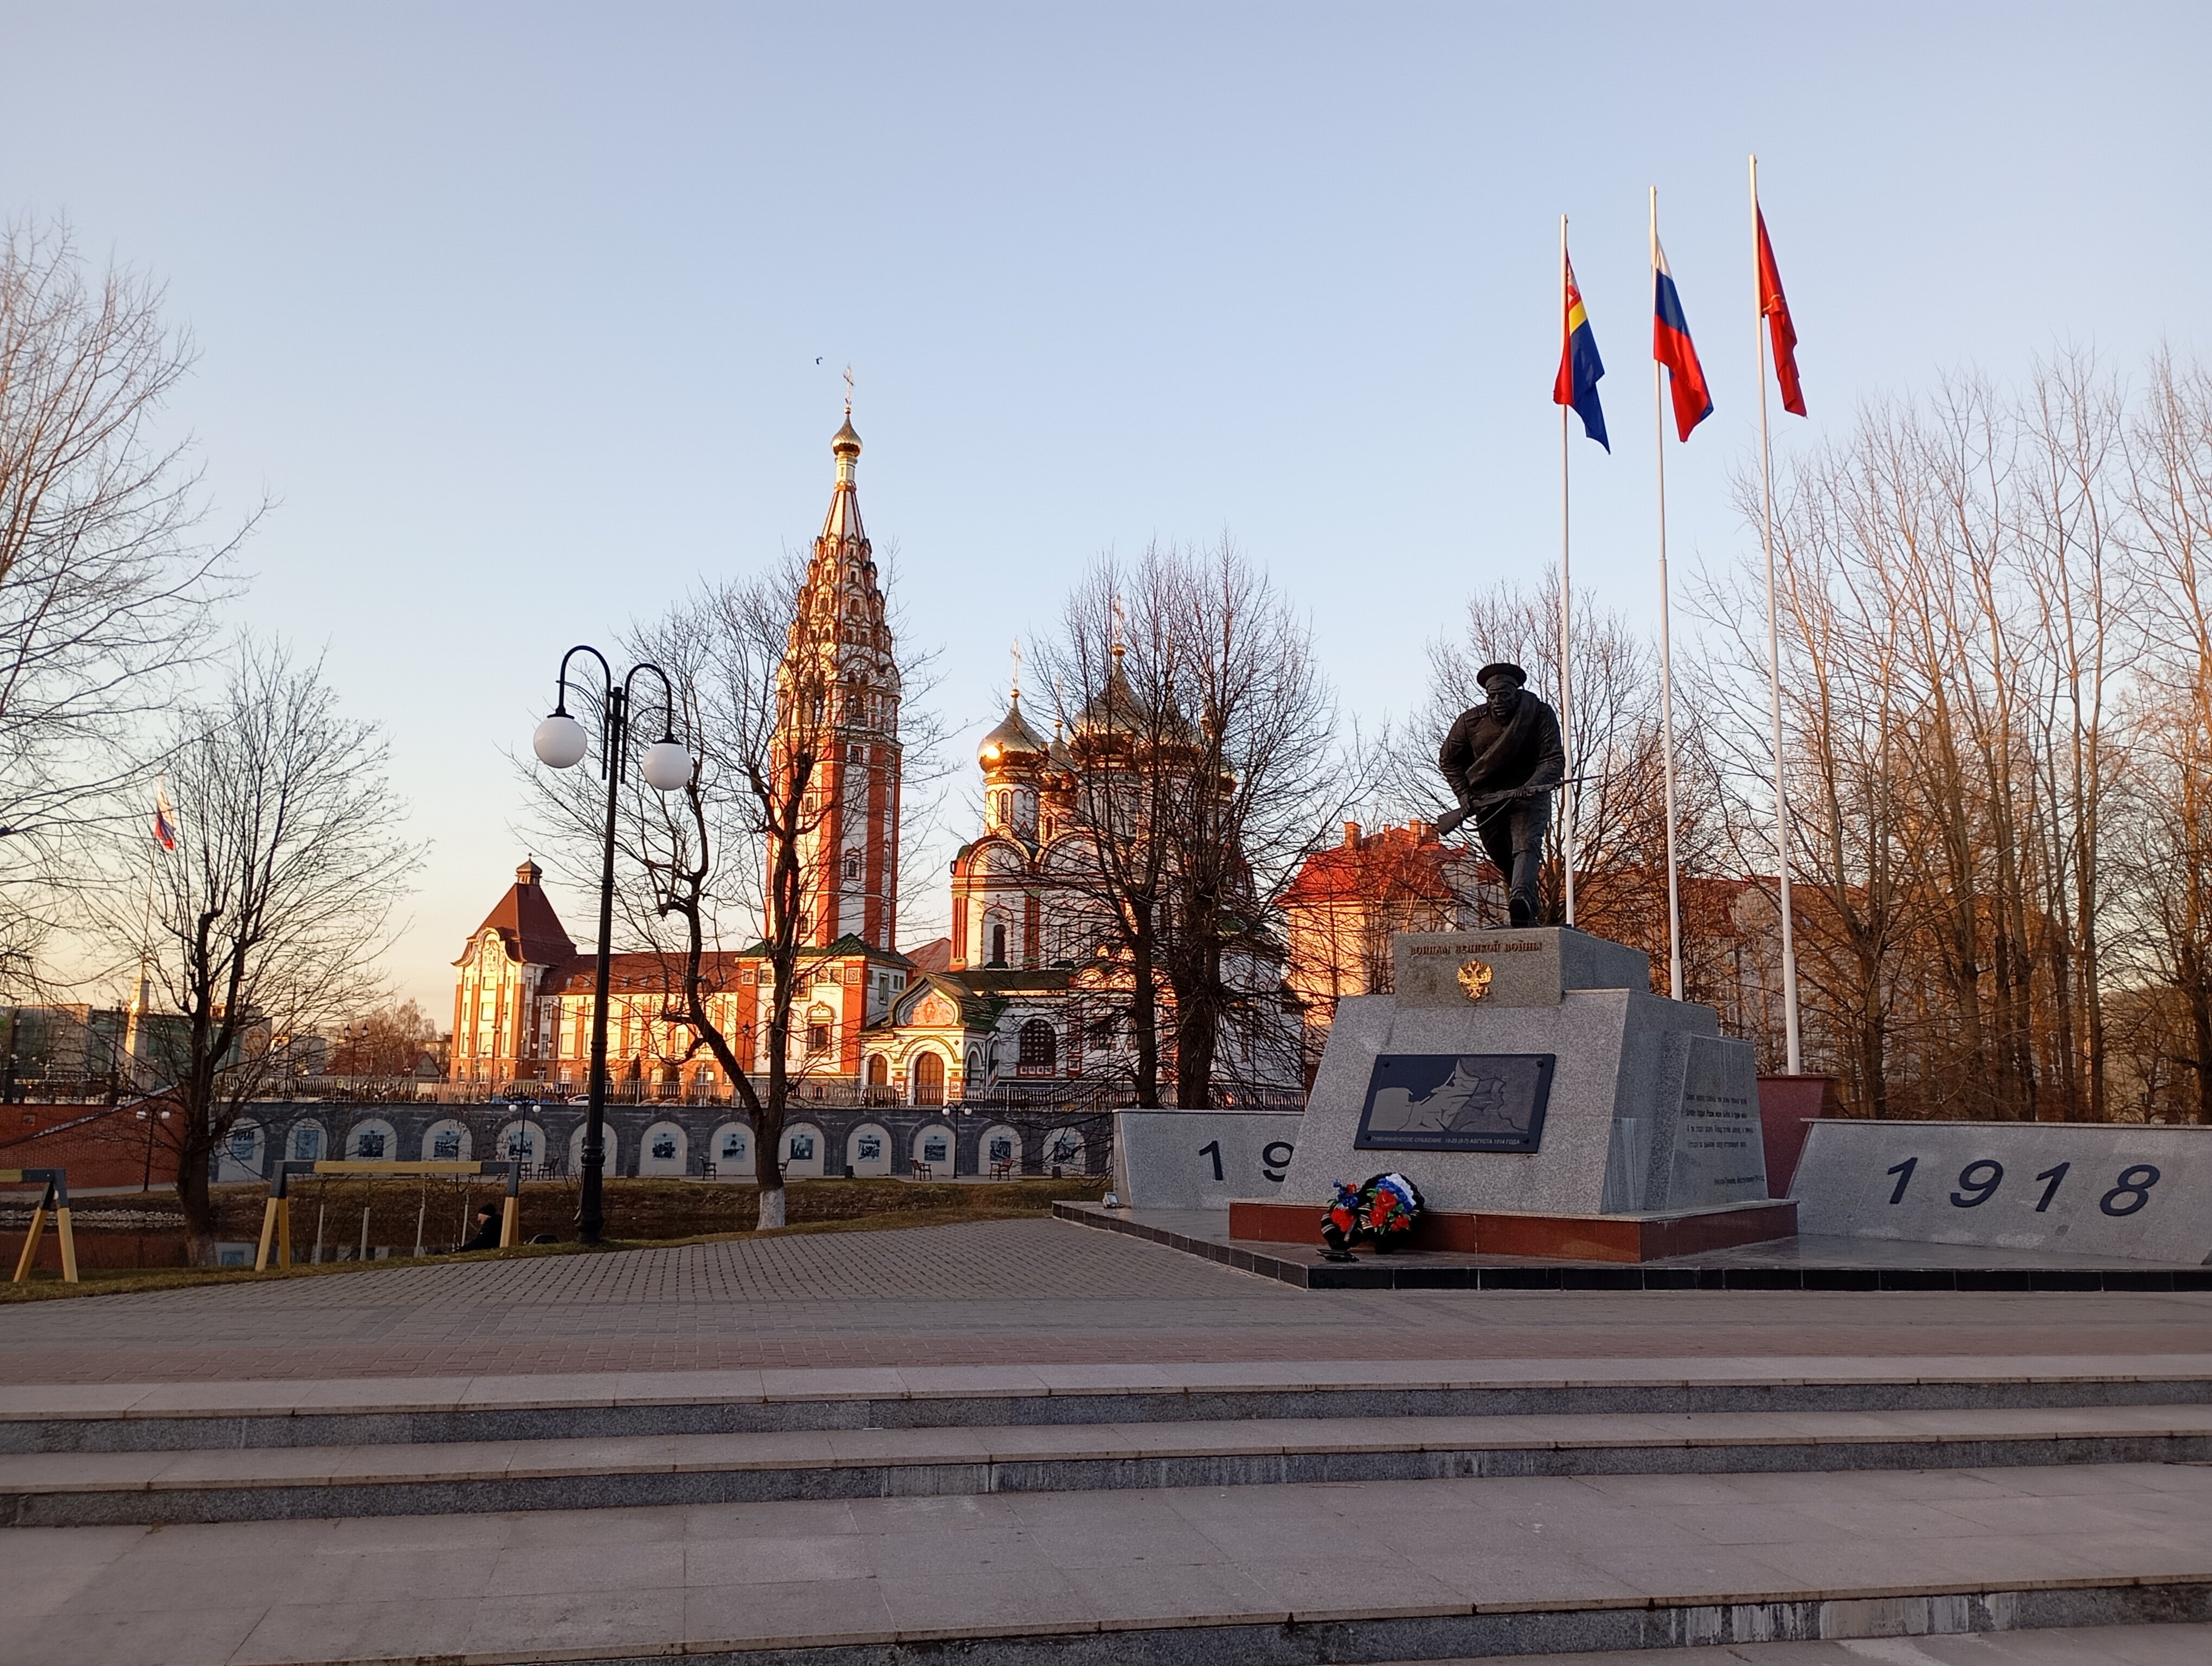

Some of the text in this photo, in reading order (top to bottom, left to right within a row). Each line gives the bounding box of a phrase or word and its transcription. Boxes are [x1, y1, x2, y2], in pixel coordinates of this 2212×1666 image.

[1411, 940, 1542, 955] ВОИНАМ ВЕЛИКОЙ ВОЙНЫ
[1886, 1157, 2161, 1217] 1918
